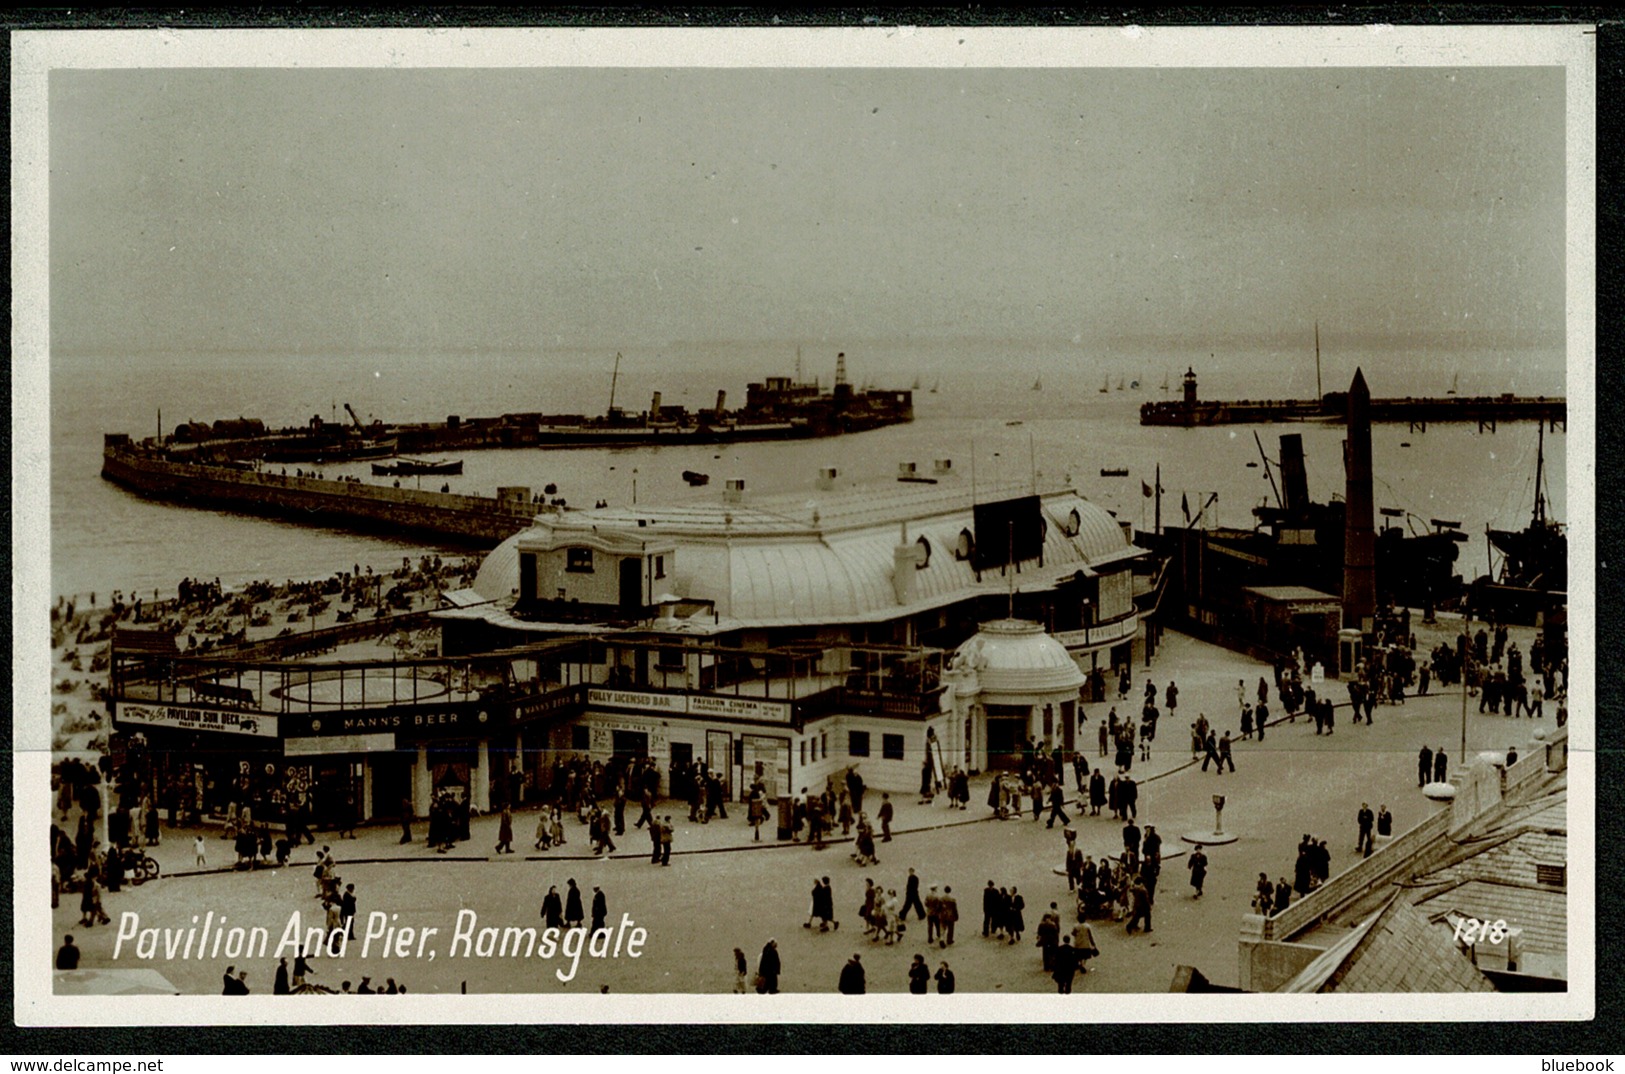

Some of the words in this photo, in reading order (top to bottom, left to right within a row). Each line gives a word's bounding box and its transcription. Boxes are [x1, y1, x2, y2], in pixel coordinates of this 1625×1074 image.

[589, 690, 613, 702] FULLY
[614, 693, 651, 706] LICENSED
[653, 697, 671, 707] BAR
[693, 698, 725, 706] PAVILION
[729, 701, 758, 710] CINEMA
[166, 708, 201, 721] PAVILION
[203, 711, 218, 723] SUN
[221, 713, 240, 725] DECK
[344, 716, 401, 729] MANN'S
[414, 713, 458, 725] BEER
